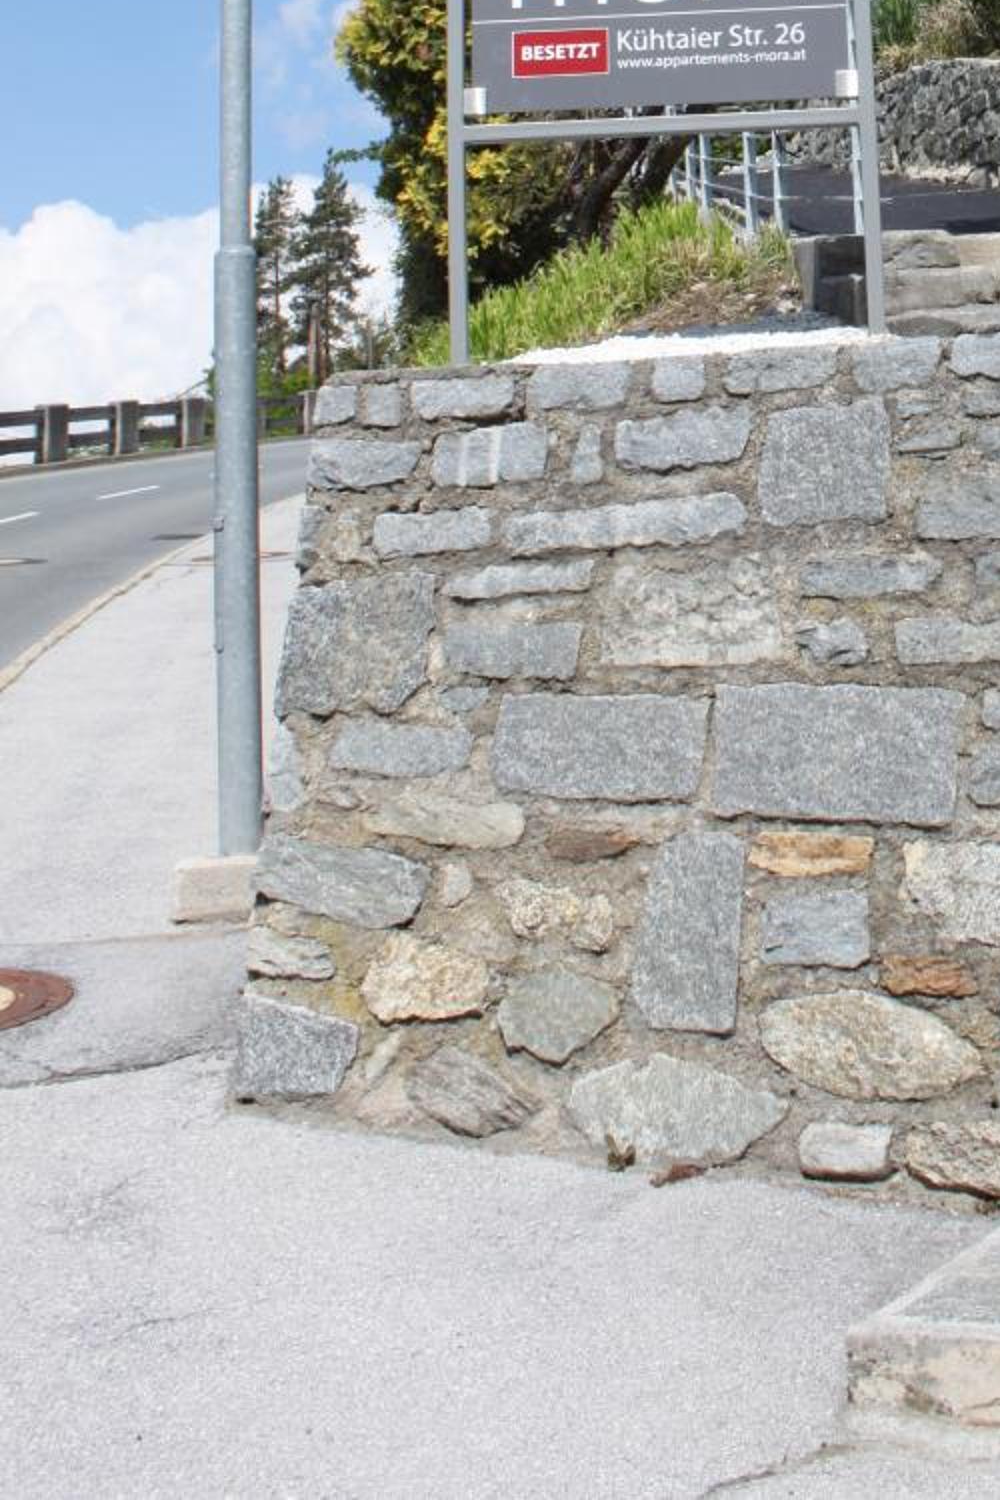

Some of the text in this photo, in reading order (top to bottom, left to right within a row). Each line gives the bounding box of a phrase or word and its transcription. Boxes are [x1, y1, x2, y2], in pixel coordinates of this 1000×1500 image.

[616, 22, 805, 52] Kühtaier Str. 26
[521, 42, 600, 62] BESETZT
[616, 49, 807, 69] www.appartements-mora.at
